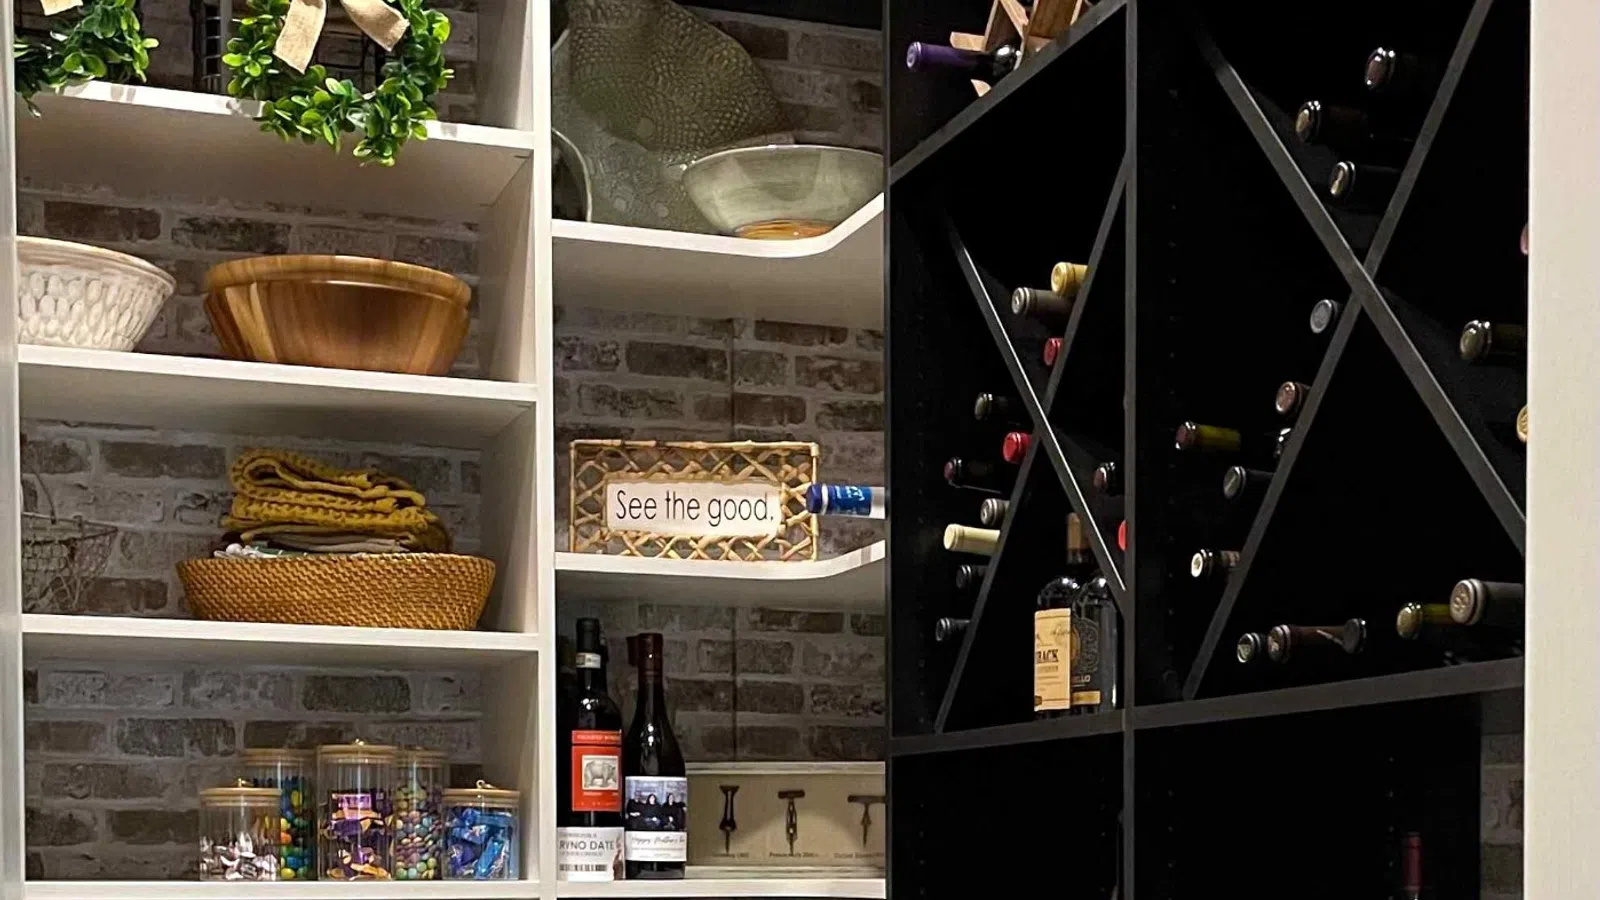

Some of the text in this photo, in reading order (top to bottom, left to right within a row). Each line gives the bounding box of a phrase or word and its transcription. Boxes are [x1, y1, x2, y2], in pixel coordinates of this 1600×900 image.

[615, 489, 774, 527] See the good.
[589, 840, 615, 850] DATE
